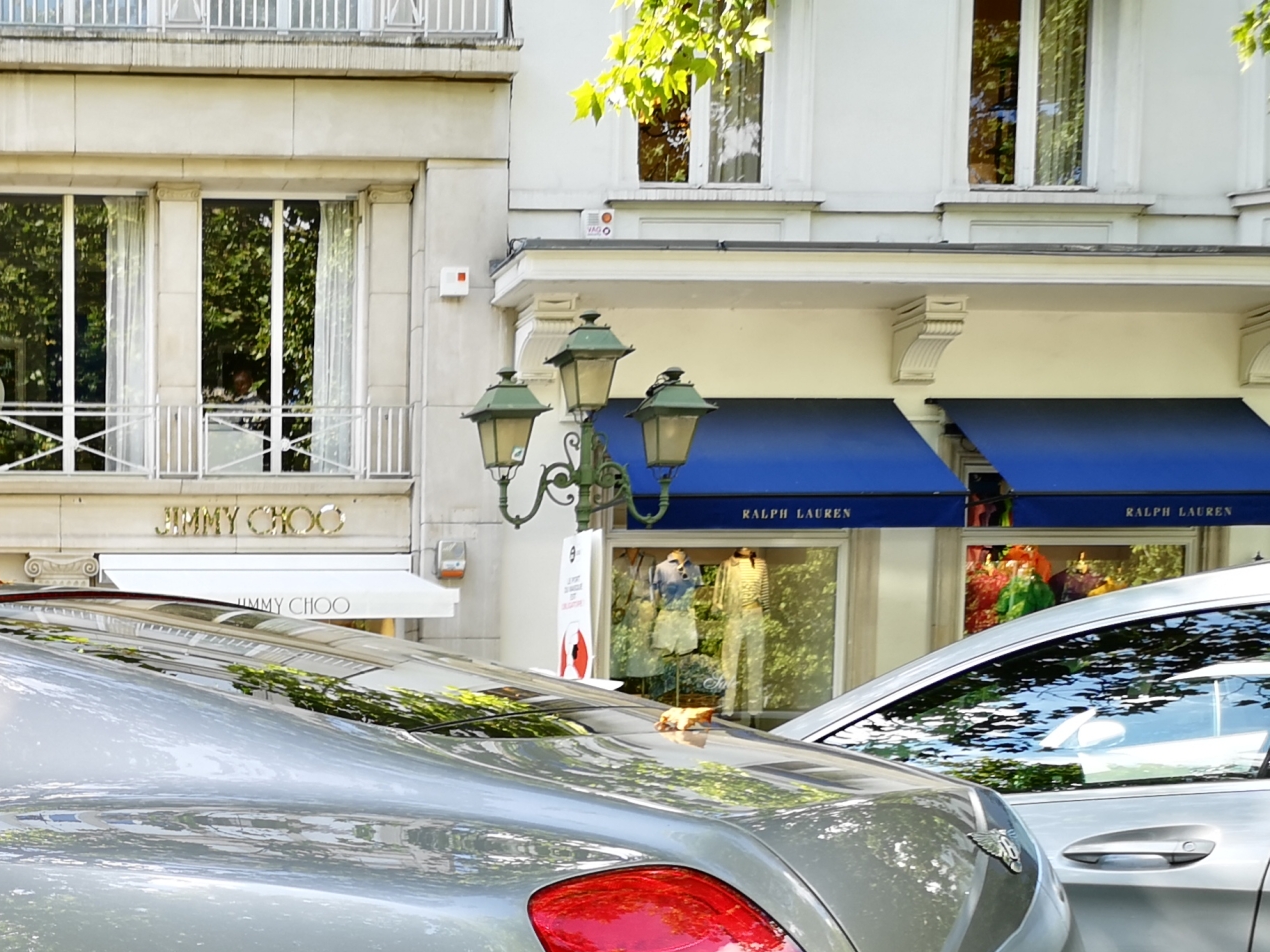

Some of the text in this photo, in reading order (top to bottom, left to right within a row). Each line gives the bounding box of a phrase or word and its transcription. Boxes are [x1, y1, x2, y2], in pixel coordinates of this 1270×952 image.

[742, 508, 851, 519] RALPH LAUREN
[1126, 506, 1232, 517] RALPH LAUREN
[155, 504, 346, 535] JIMMY CHOO
[289, 597, 350, 615] CHOO
